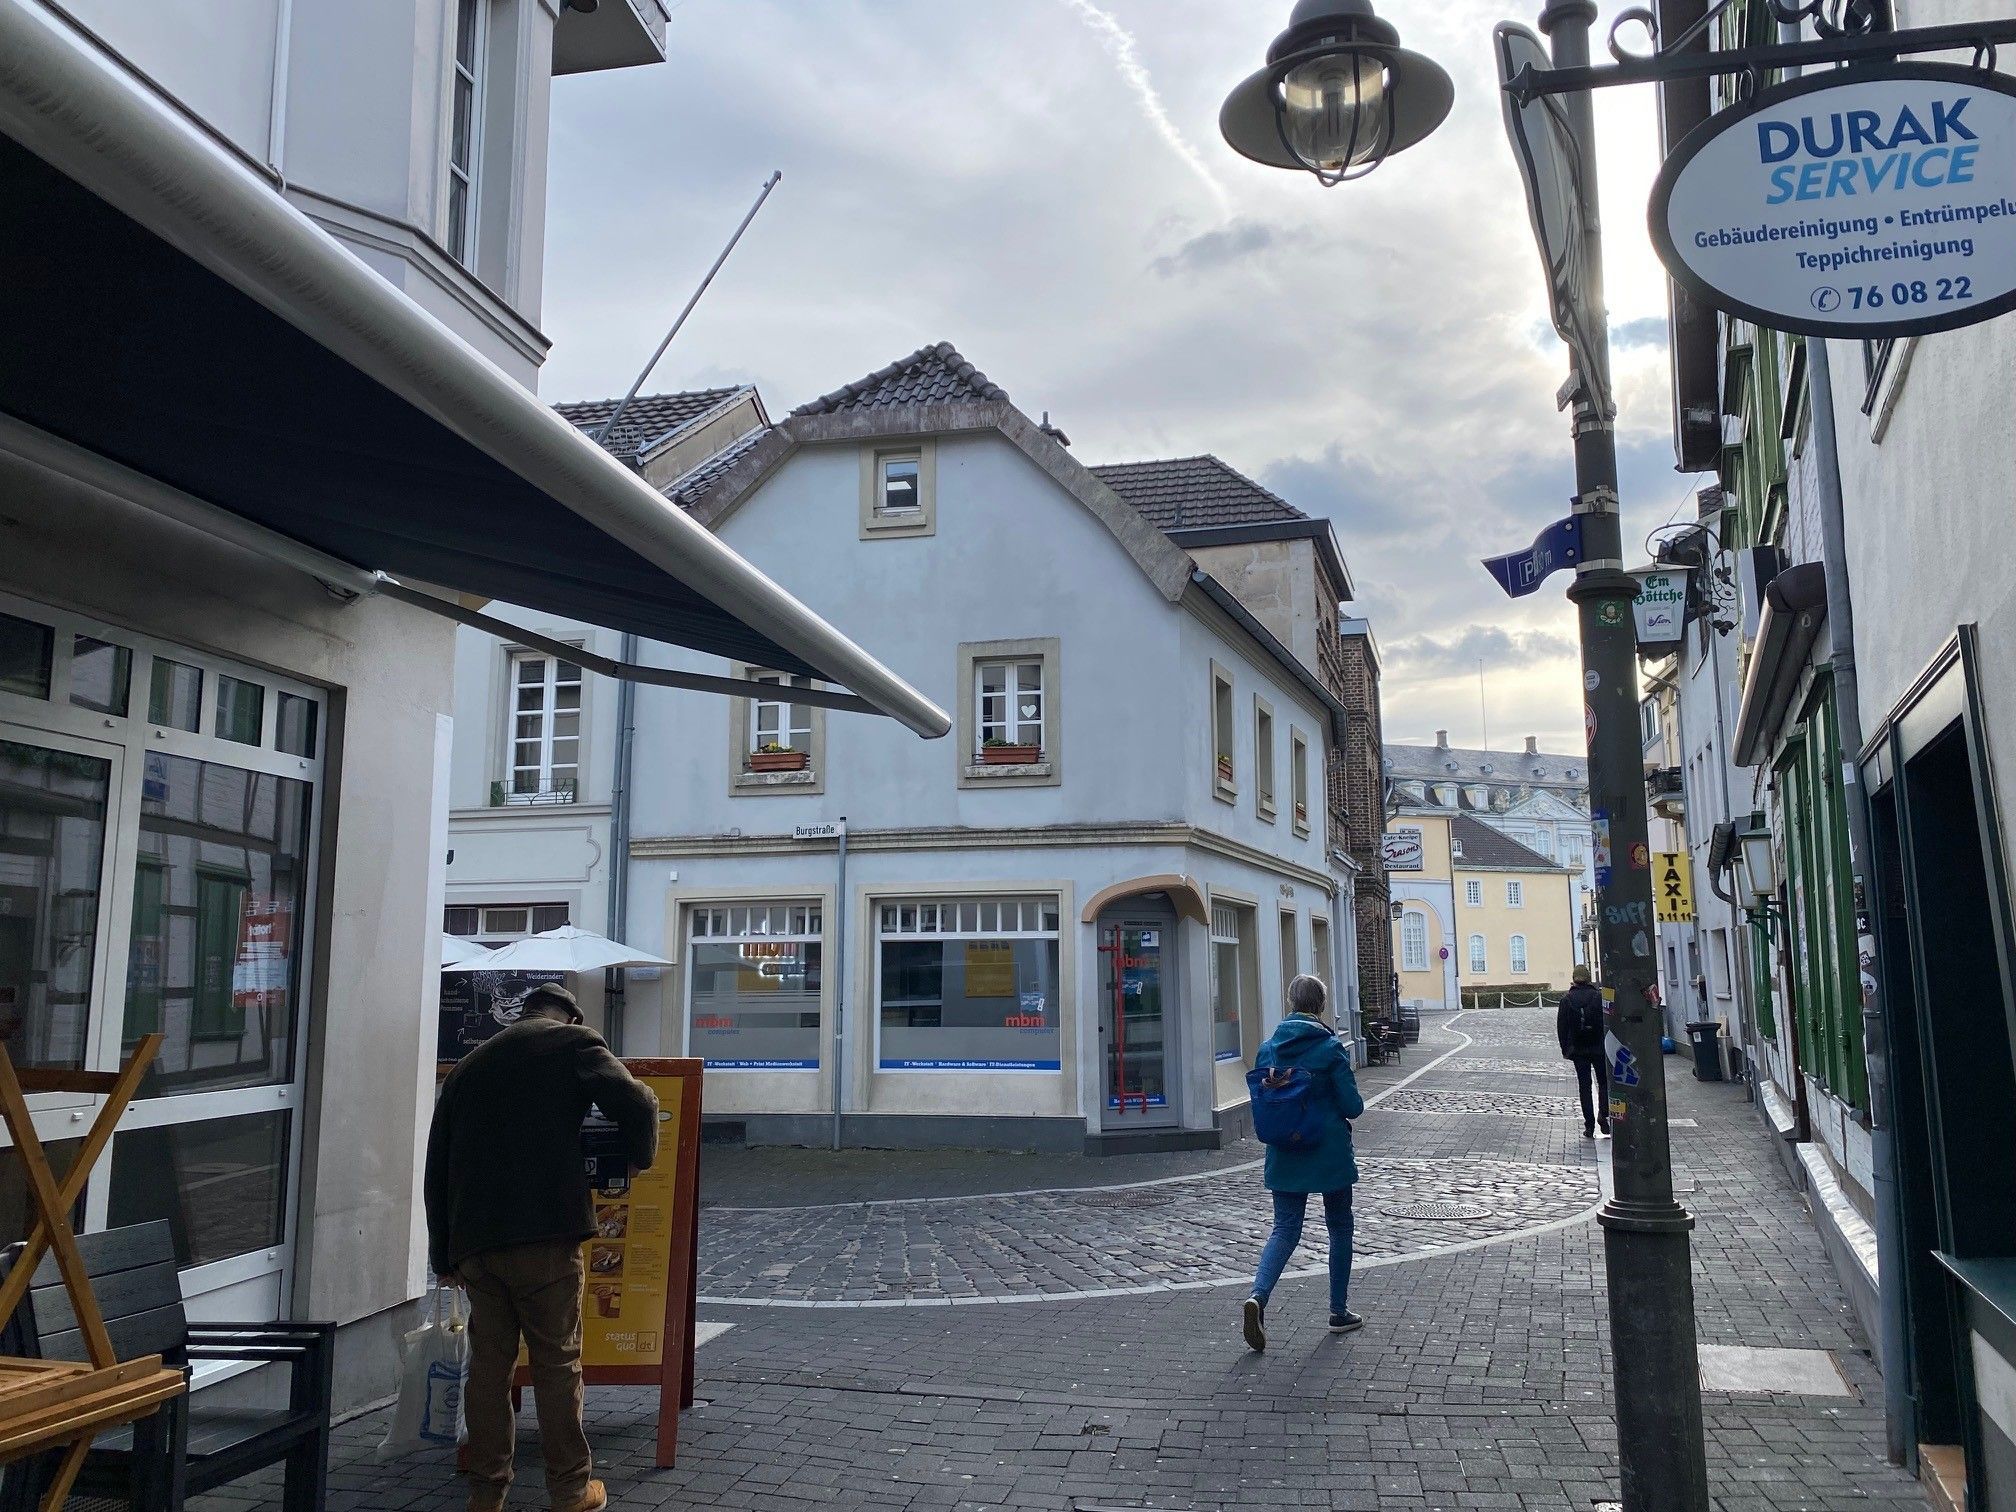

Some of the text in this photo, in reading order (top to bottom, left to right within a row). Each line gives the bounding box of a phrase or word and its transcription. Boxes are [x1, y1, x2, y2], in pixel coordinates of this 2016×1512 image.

[1757, 97, 1979, 164] DURAK
[1766, 145, 1980, 205] SERVICE
[1694, 214, 1879, 248] Gebäudereinigung
[1796, 238, 1974, 272] Teppichreinigung
[1847, 275, 1973, 310] 76 08 22
[1645, 575, 1670, 589] Em
[796, 824, 835, 837] Burgstraße
[1382, 841, 1419, 862] Seasons
[1663, 853, 1683, 912] TAXI
[1658, 912, 1692, 921] 3 11 11
[1005, 1012, 1046, 1027] mbm
[604, 1332, 636, 1342] status
[616, 1342, 636, 1352] quo
